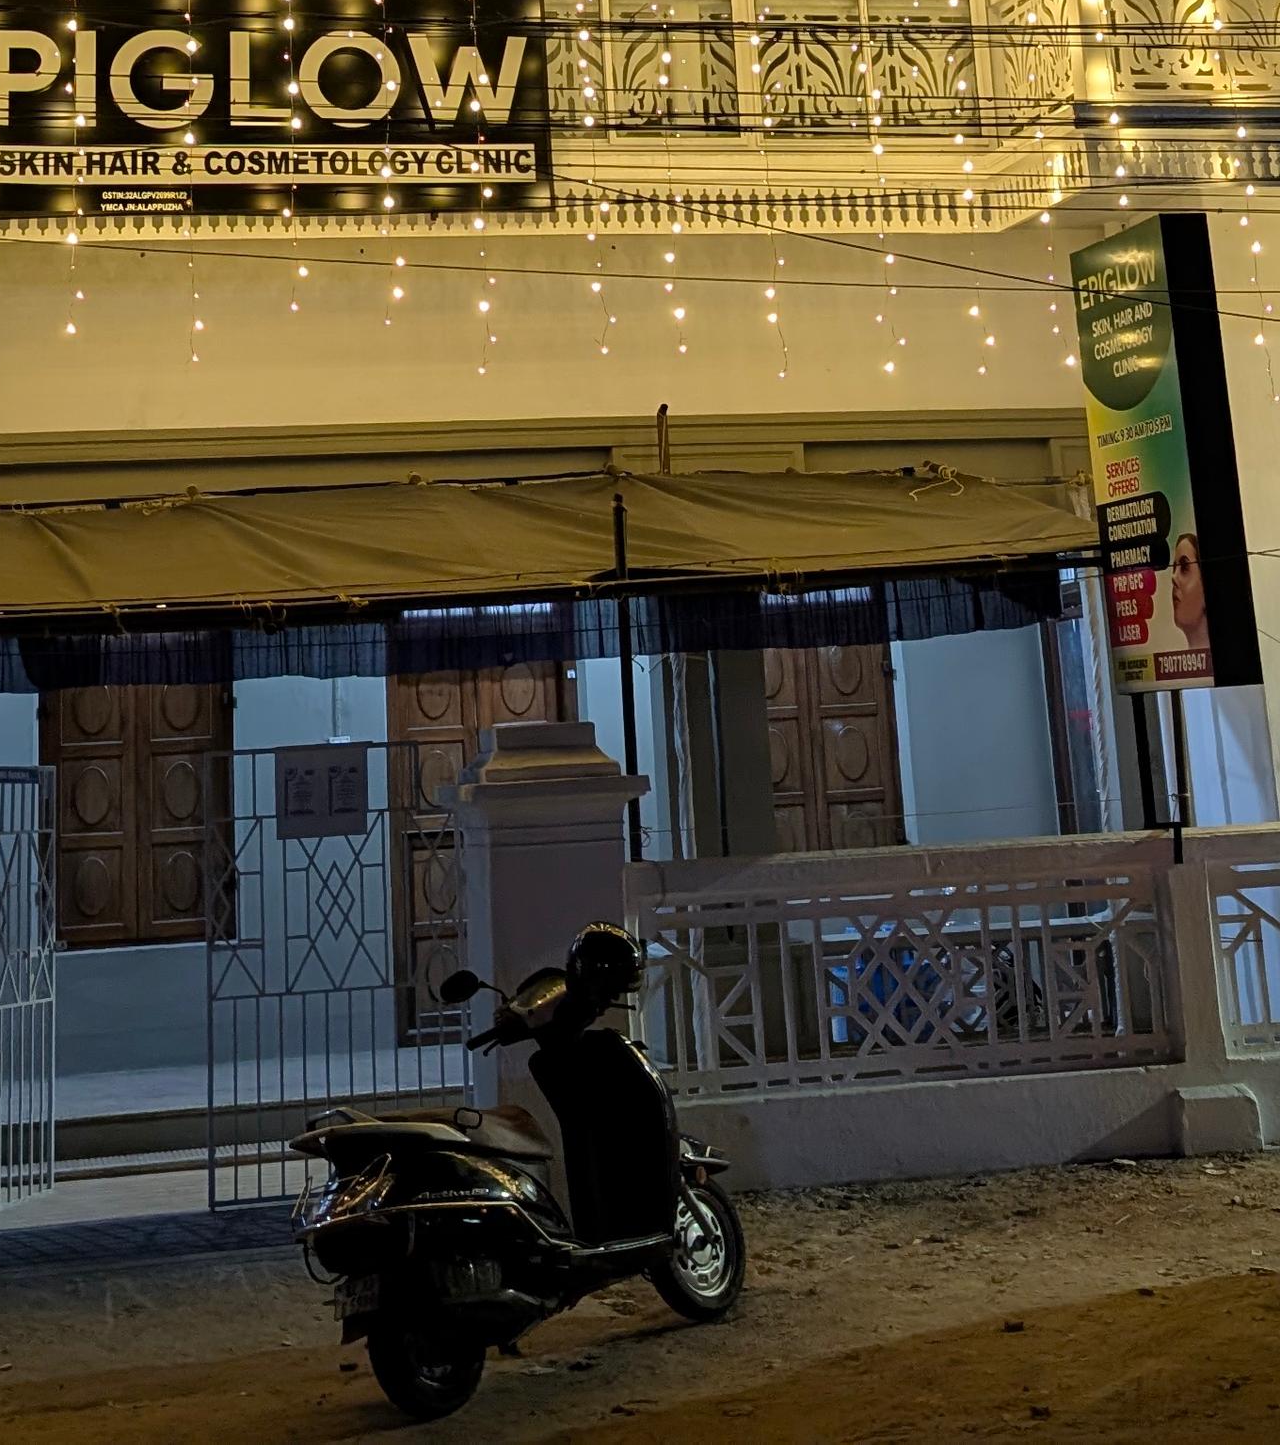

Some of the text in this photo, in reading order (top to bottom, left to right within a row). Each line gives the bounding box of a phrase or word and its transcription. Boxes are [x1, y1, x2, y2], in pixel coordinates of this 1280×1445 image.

[172, 150, 192, 176] &
[203, 150, 435, 176] COSMETOLOGY
[435, 149, 534, 175] CLINIC
[100, 203, 124, 212] YMCA
[1078, 249, 1156, 311] EPIGLOW
[1091, 301, 1153, 338] SKIN, HAIR AND
[1094, 325, 1154, 361] COSMETOLOGY
[1112, 355, 1140, 378] CLINIC
[1105, 456, 1140, 480] SERVICES
[1107, 476, 1140, 498] OFFERED
[1106, 497, 1154, 523] DERMATOLOGY
[1108, 517, 1158, 542] CONSULTATION
[1110, 544, 1151, 569] PHARMACY
[1115, 598, 1138, 618] PEELS
[1118, 623, 1142, 643] LASER
